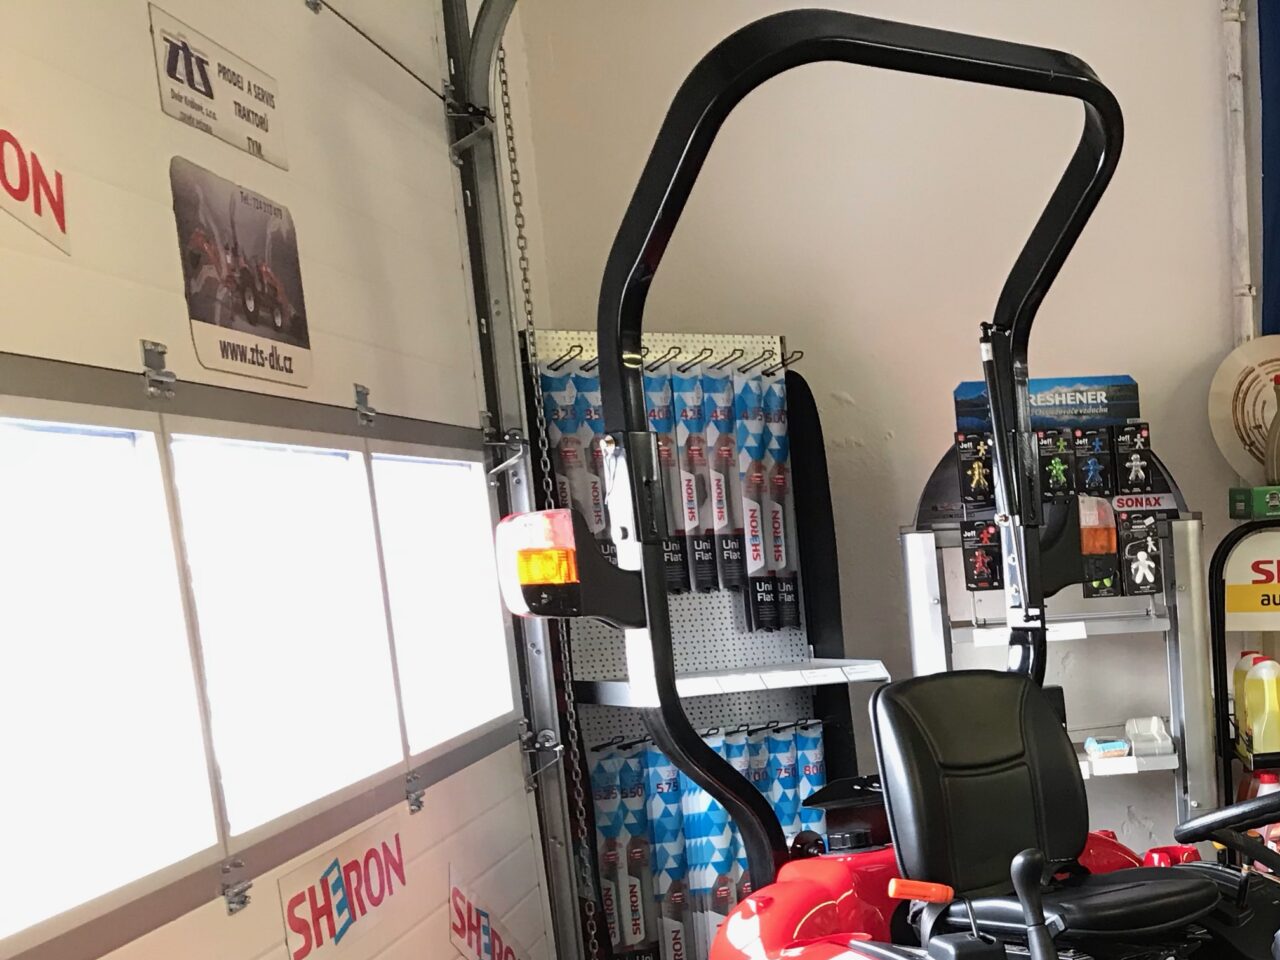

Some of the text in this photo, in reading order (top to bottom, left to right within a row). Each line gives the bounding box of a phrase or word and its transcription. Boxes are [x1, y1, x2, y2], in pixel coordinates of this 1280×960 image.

[217, 62, 244, 91] PRODEJ
[253, 83, 276, 110] SERVIS
[219, 338, 294, 374] www.zts-dk.cz
[1029, 390, 1109, 407] RESHENER
[959, 441, 973, 450] Jeff
[685, 478, 697, 522] SHERON
[714, 478, 726, 522] SHERON
[1116, 497, 1162, 509] SONAX
[749, 508, 762, 562] SHERON
[771, 510, 783, 562] SHERON
[963, 530, 976, 538] Jeff
[662, 541, 680, 551] Uni
[694, 540, 711, 550] Uni
[723, 539, 739, 550] Uni
[664, 552, 683, 562] Flat
[695, 551, 713, 561] Flat
[724, 550, 741, 560] Flat
[757, 581, 773, 592] Uni
[778, 581, 794, 592] Uni
[757, 592, 774, 602] Flat
[778, 592, 795, 602] Flat
[776, 768, 797, 778] 750
[803, 765, 824, 776] 800
[656, 780, 679, 793] 575
[603, 887, 617, 939] SHERON
[629, 884, 642, 936] SHERON
